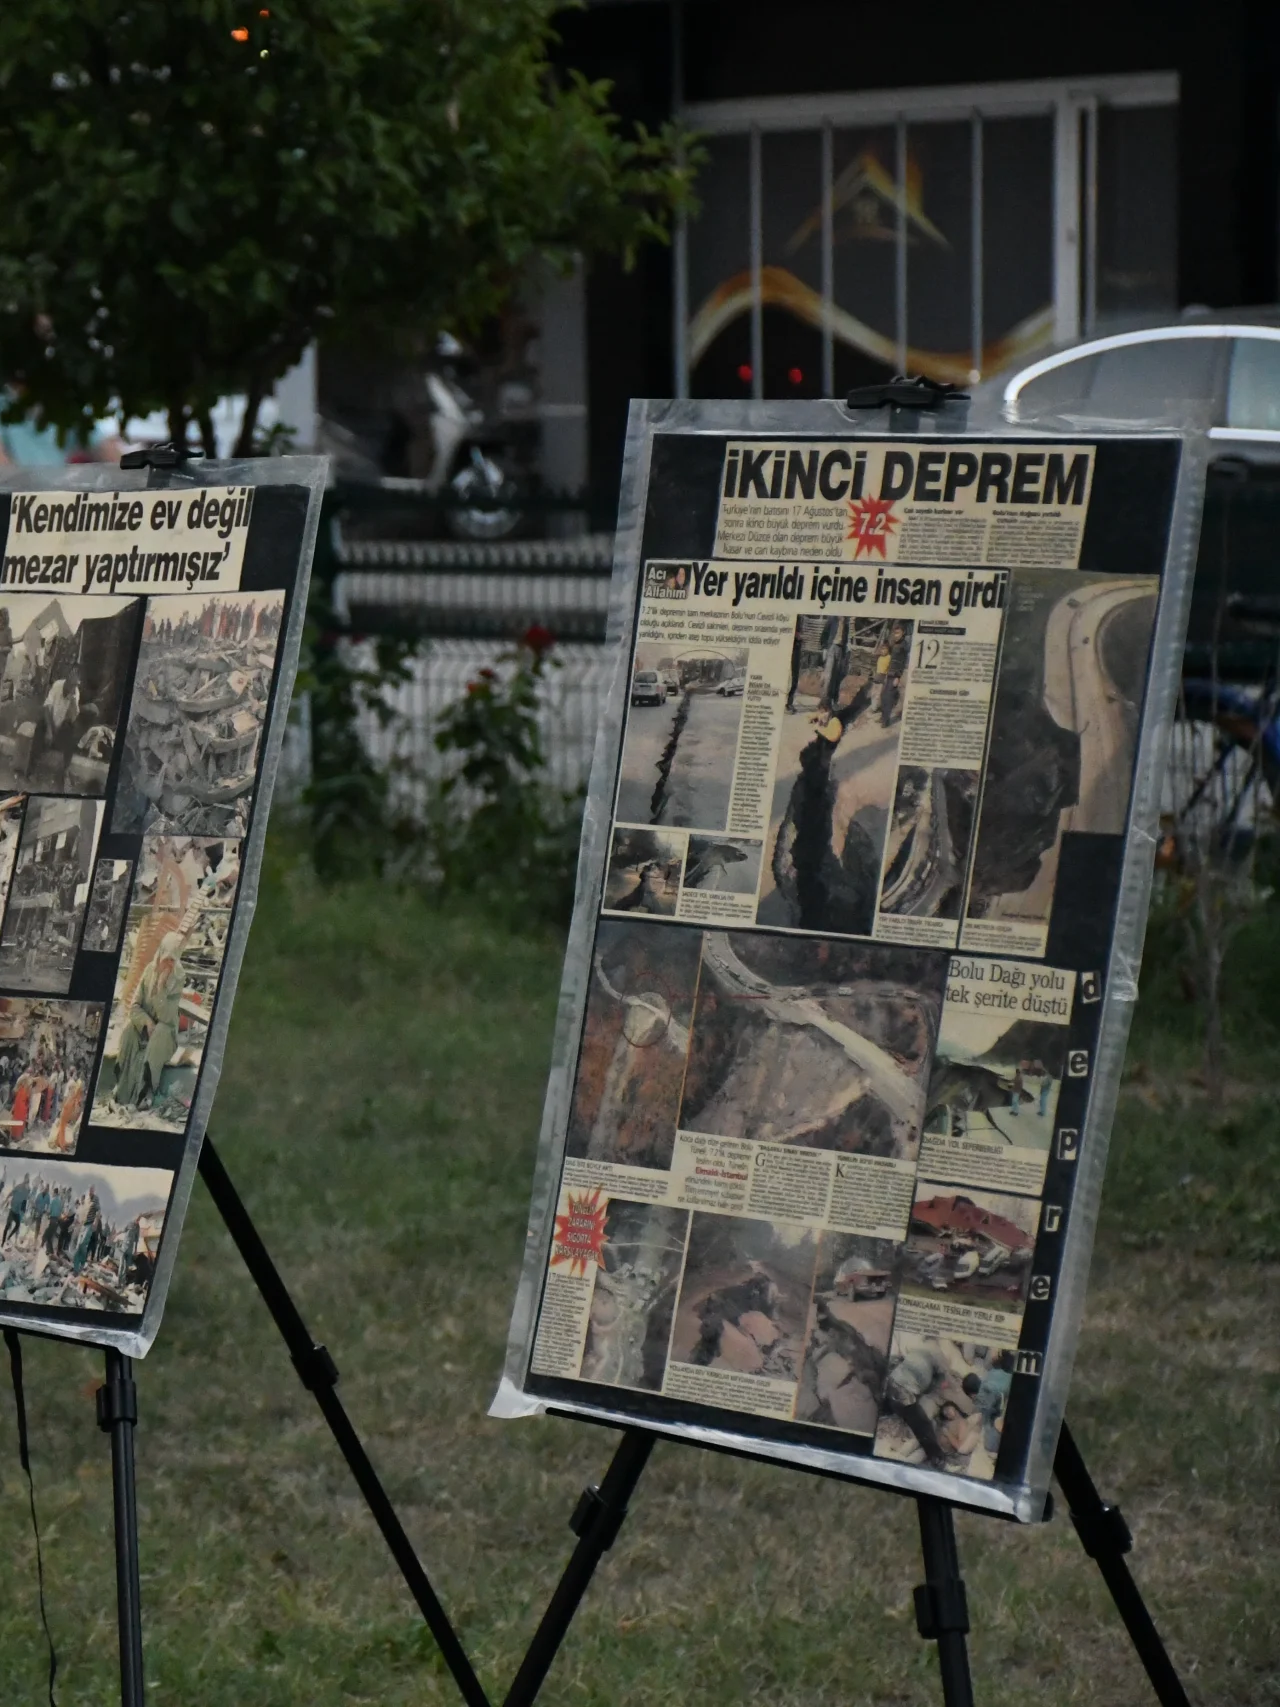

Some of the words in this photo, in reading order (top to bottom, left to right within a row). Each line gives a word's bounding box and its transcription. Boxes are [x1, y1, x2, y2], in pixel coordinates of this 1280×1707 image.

[879, 450, 1090, 507] DEPREM
[150, 499, 183, 531] ev
[186, 486, 254, 539] değil
[860, 512, 887, 536] 7.2
[0, 553, 79, 585] mezar
[692, 561, 729, 597] Yer
[731, 565, 805, 607] yarıldı
[810, 566, 869, 610] içine
[874, 568, 943, 606] insan
[947, 571, 1008, 617] girdi
[947, 958, 985, 981] Bolu
[988, 963, 1027, 989] Dağı
[1028, 970, 1066, 991] yolu
[945, 983, 970, 1005] tek
[973, 988, 1018, 1010] şerite
[1020, 991, 1068, 1018] düştü
